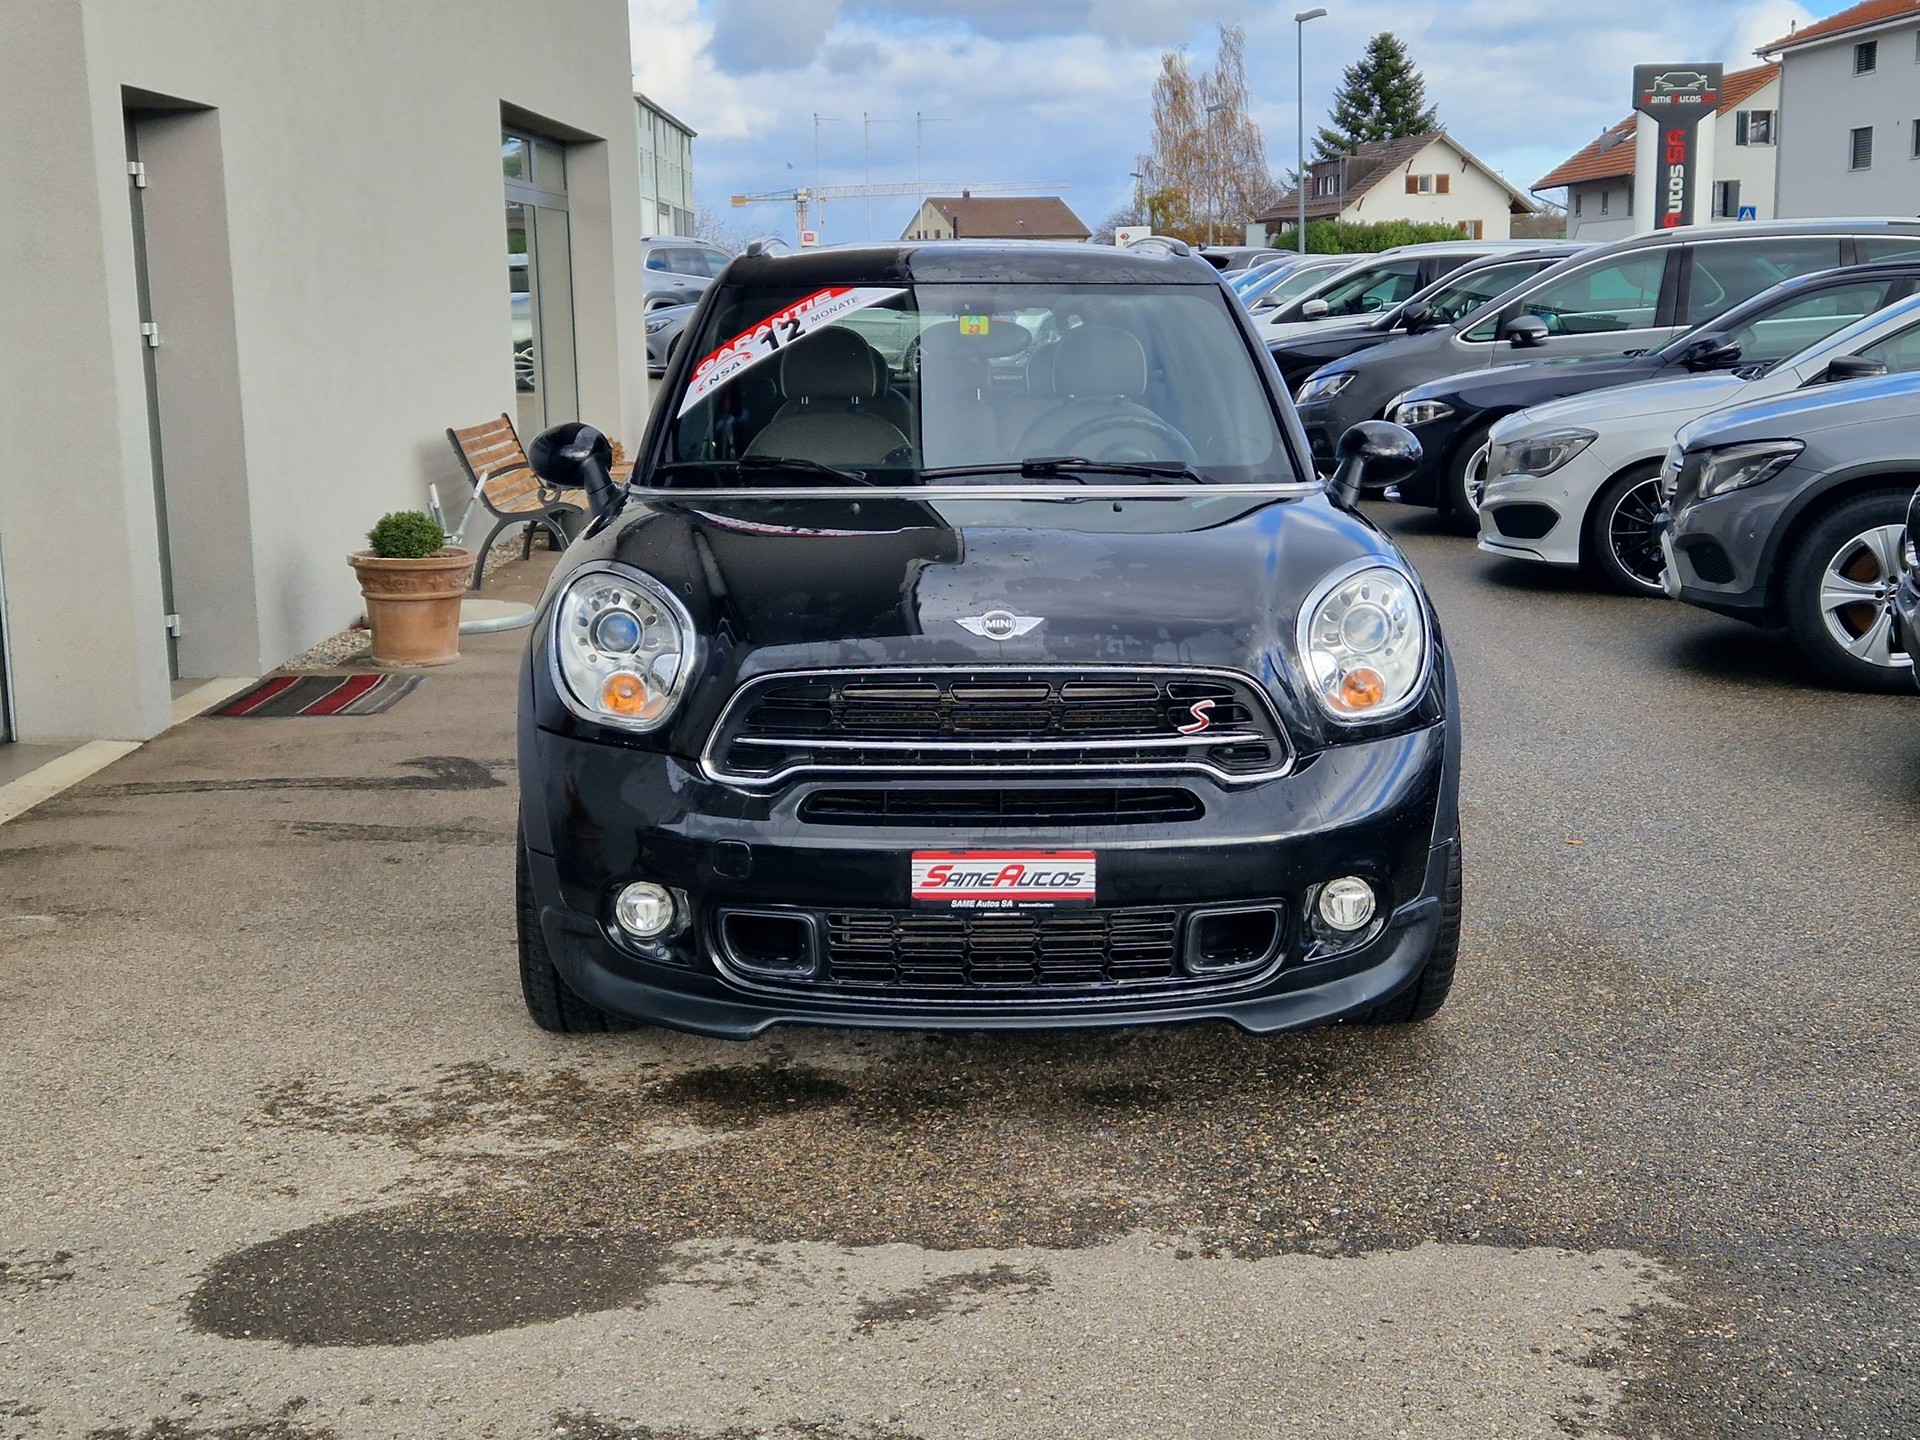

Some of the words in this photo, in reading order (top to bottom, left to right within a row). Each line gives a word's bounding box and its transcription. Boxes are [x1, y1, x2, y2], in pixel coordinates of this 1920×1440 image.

[696, 290, 832, 376] GARANTIE
[761, 318, 806, 351] 12
[810, 295, 860, 323] MONATE
[709, 361, 741, 386] NSA
[985, 619, 1013, 628] MINI
[1177, 699, 1216, 734] S
[950, 899, 975, 908] SAME
[976, 899, 1000, 908] Autos
[1001, 899, 1013, 908] SA
